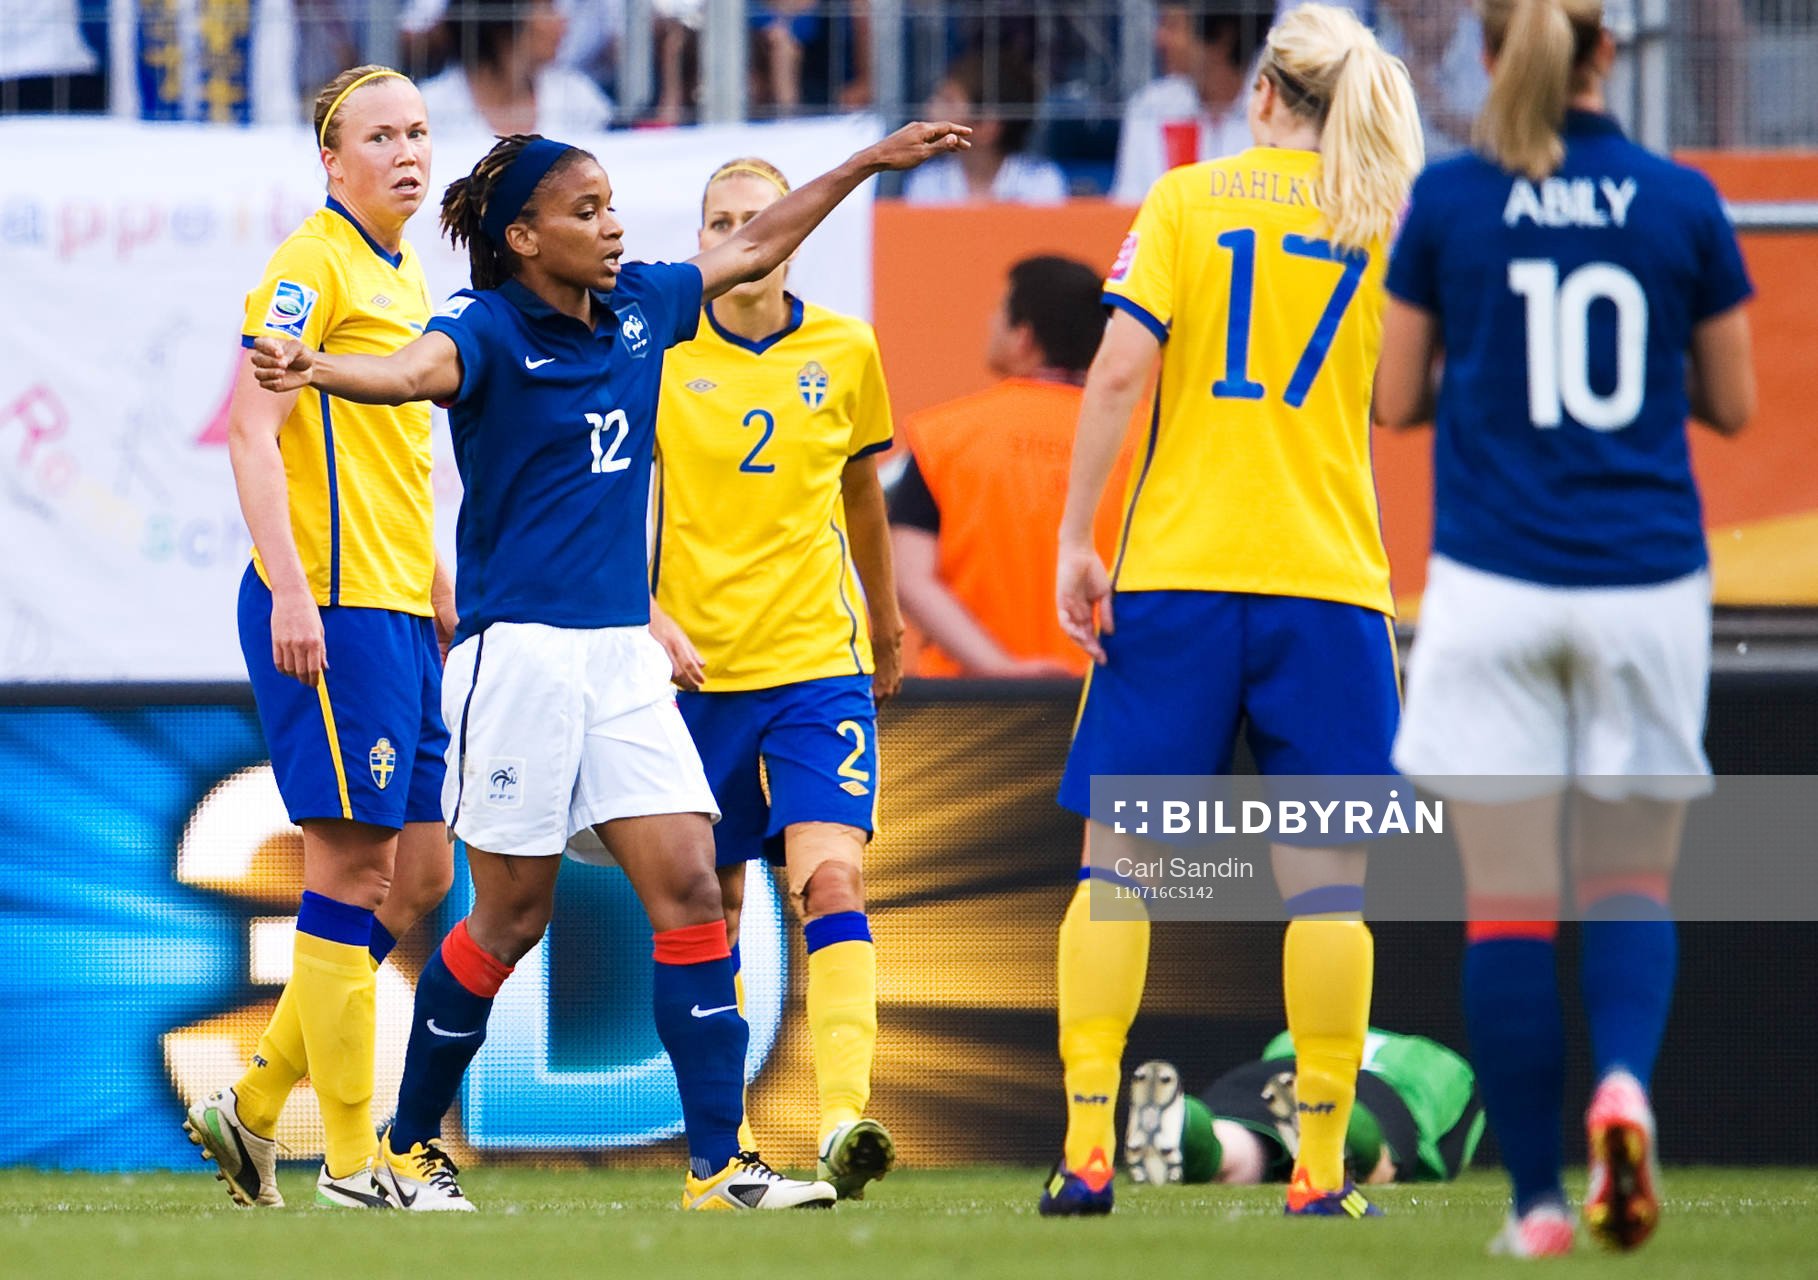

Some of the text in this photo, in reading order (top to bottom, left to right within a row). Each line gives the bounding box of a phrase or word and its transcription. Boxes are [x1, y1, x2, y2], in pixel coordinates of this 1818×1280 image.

[1503, 176, 1637, 229] ABILY
[1212, 228, 1371, 409] 17
[1508, 259, 1649, 431] 10
[584, 409, 632, 474] 12
[739, 409, 776, 474] 2
[836, 719, 870, 782] 2
